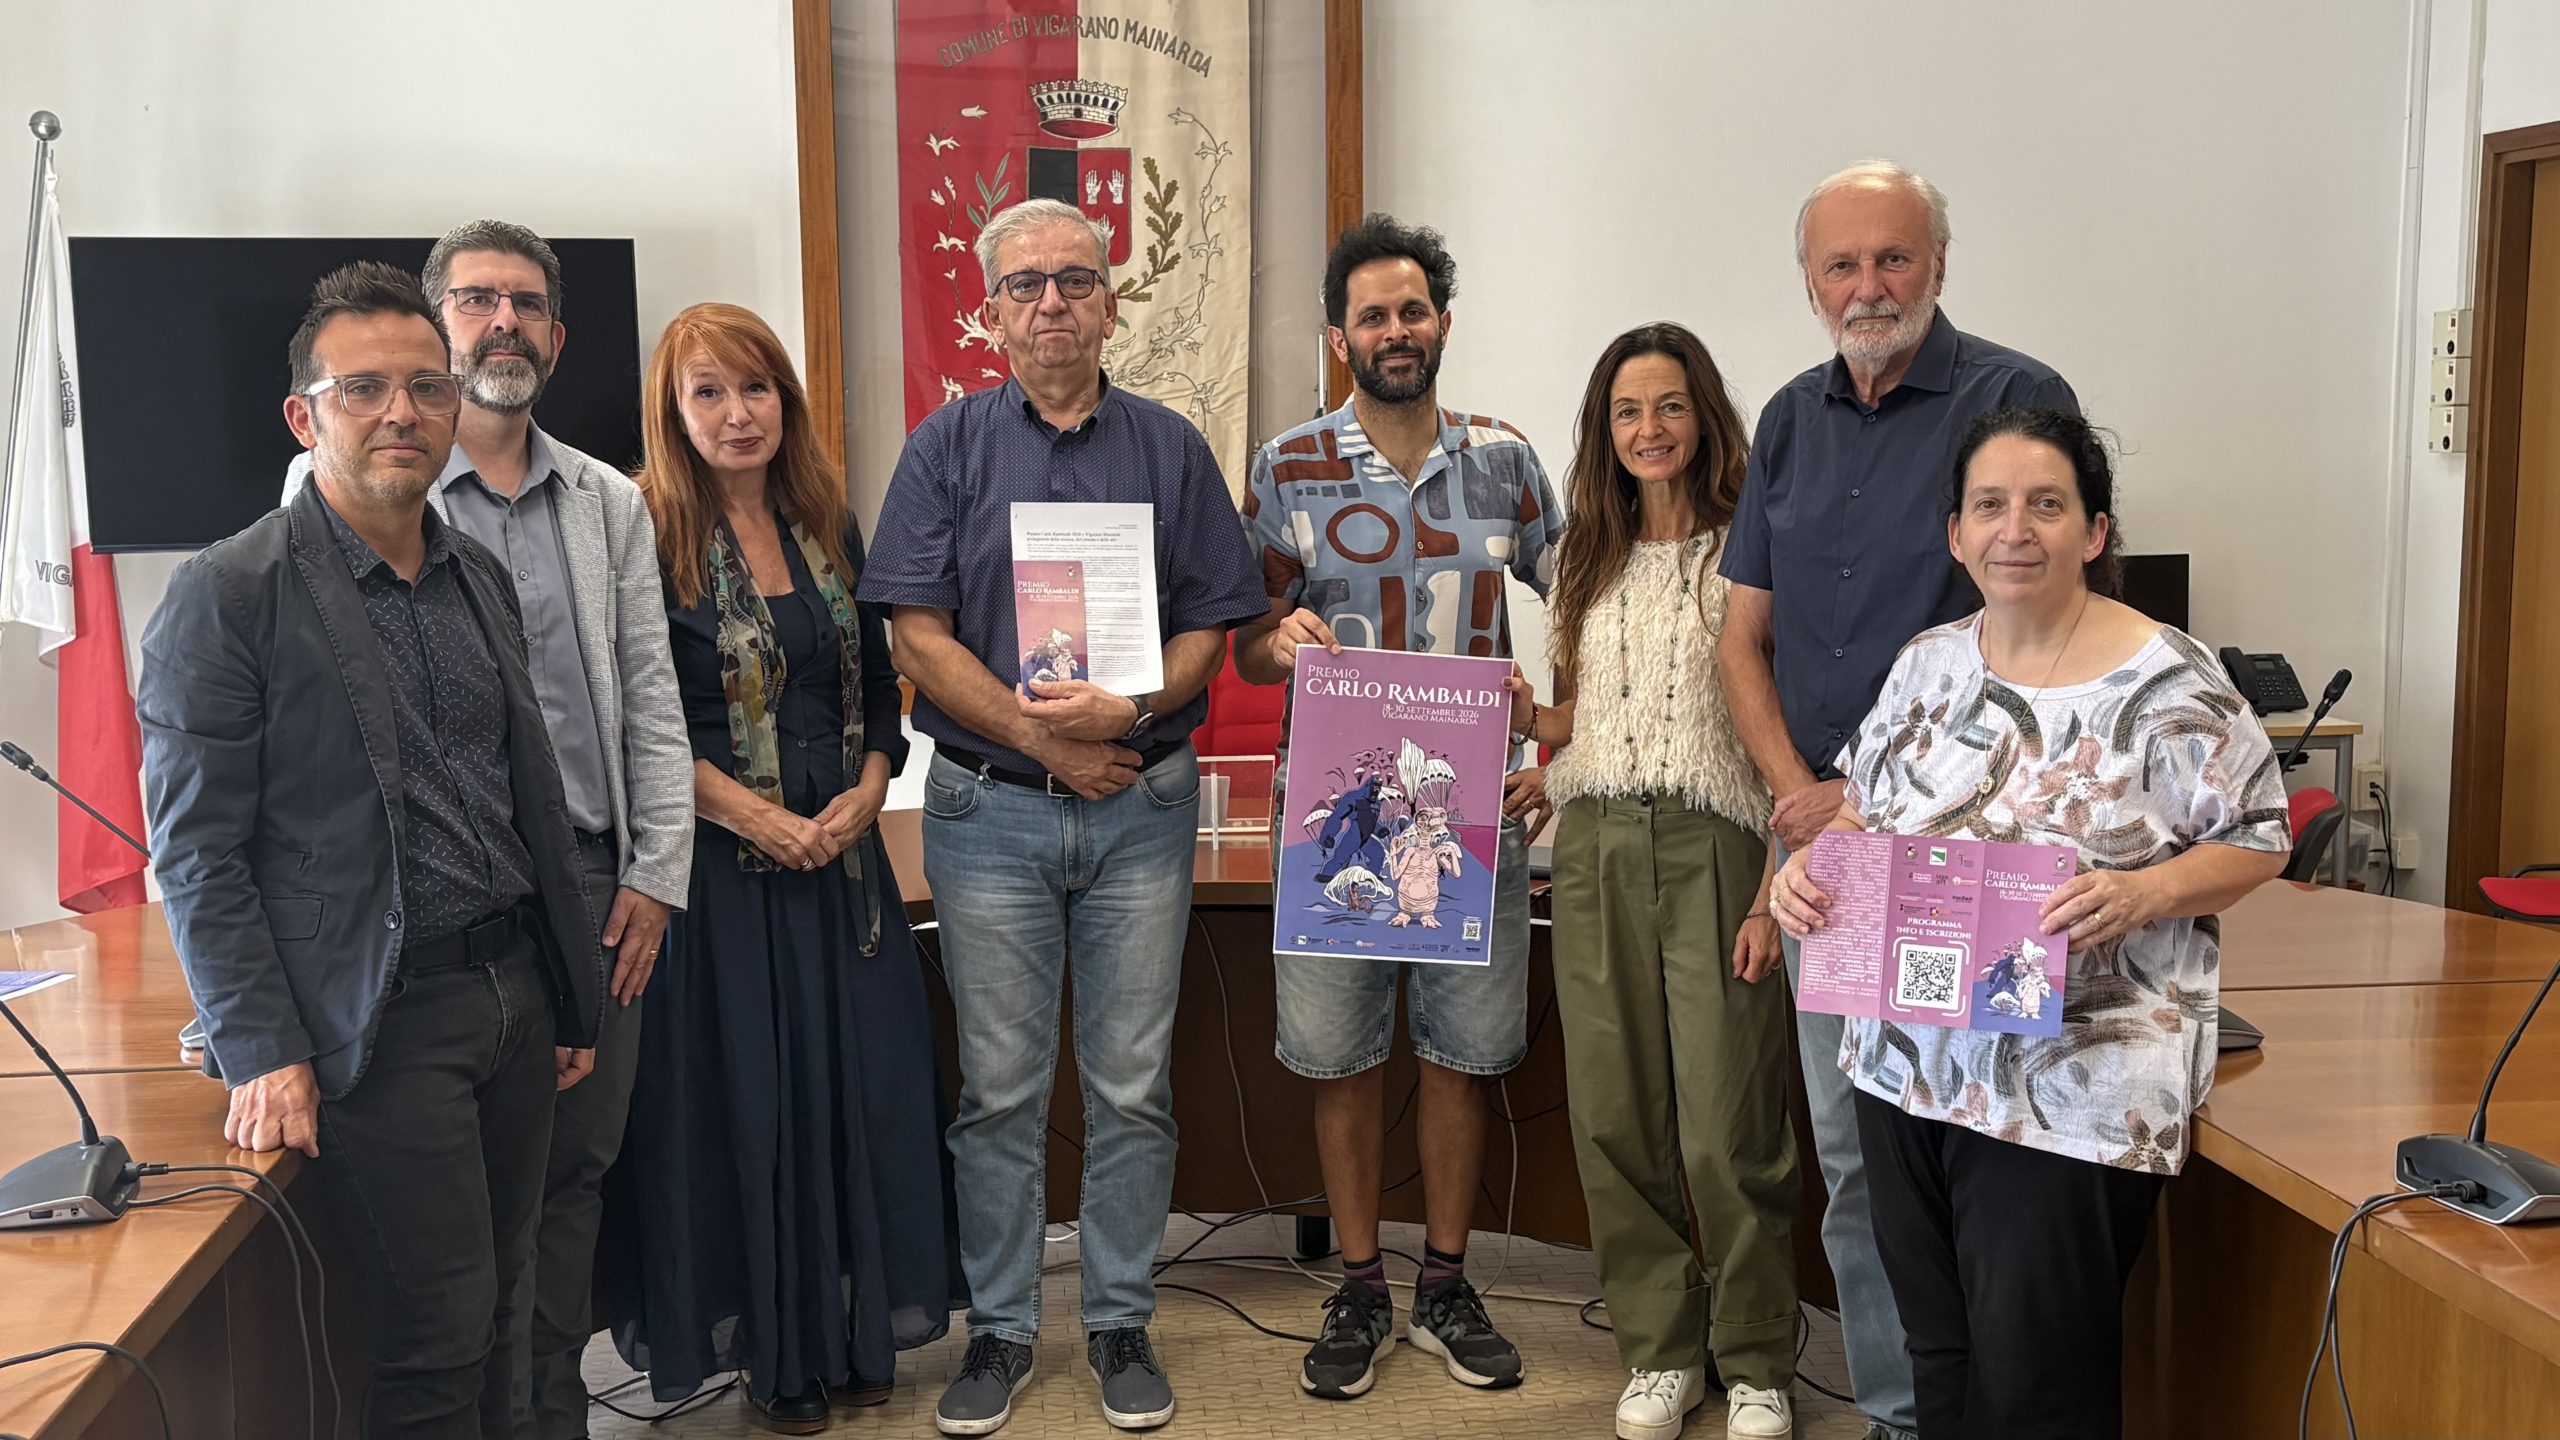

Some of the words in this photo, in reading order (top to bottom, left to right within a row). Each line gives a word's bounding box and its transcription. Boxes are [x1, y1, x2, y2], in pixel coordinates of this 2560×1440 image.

[937, 22, 1009, 68] COMUNE
[1012, 16, 1028, 39] DI
[1032, 14, 1119, 40] VIGARANO
[1123, 18, 1212, 78] MAINARDA
[35, 559, 73, 587] VIG
[1307, 664, 1360, 680] PREMIO
[1306, 678, 1382, 699] CARLO
[1387, 683, 1500, 708] RAMBALDI
[1382, 708, 1428, 722] VIGARANO
[1430, 714, 1478, 726] MAINARDA
[1406, 705, 1456, 717] SETTEMBRE
[1458, 709, 1480, 719] 2026
[1986, 869, 2030, 882] PREMIO
[1984, 879, 2018, 889] CARLO
[1907, 917, 1962, 929] PROGRAMMA
[1896, 926, 1918, 935] INFO
[1925, 929, 1972, 939] ISCRIZIONI
